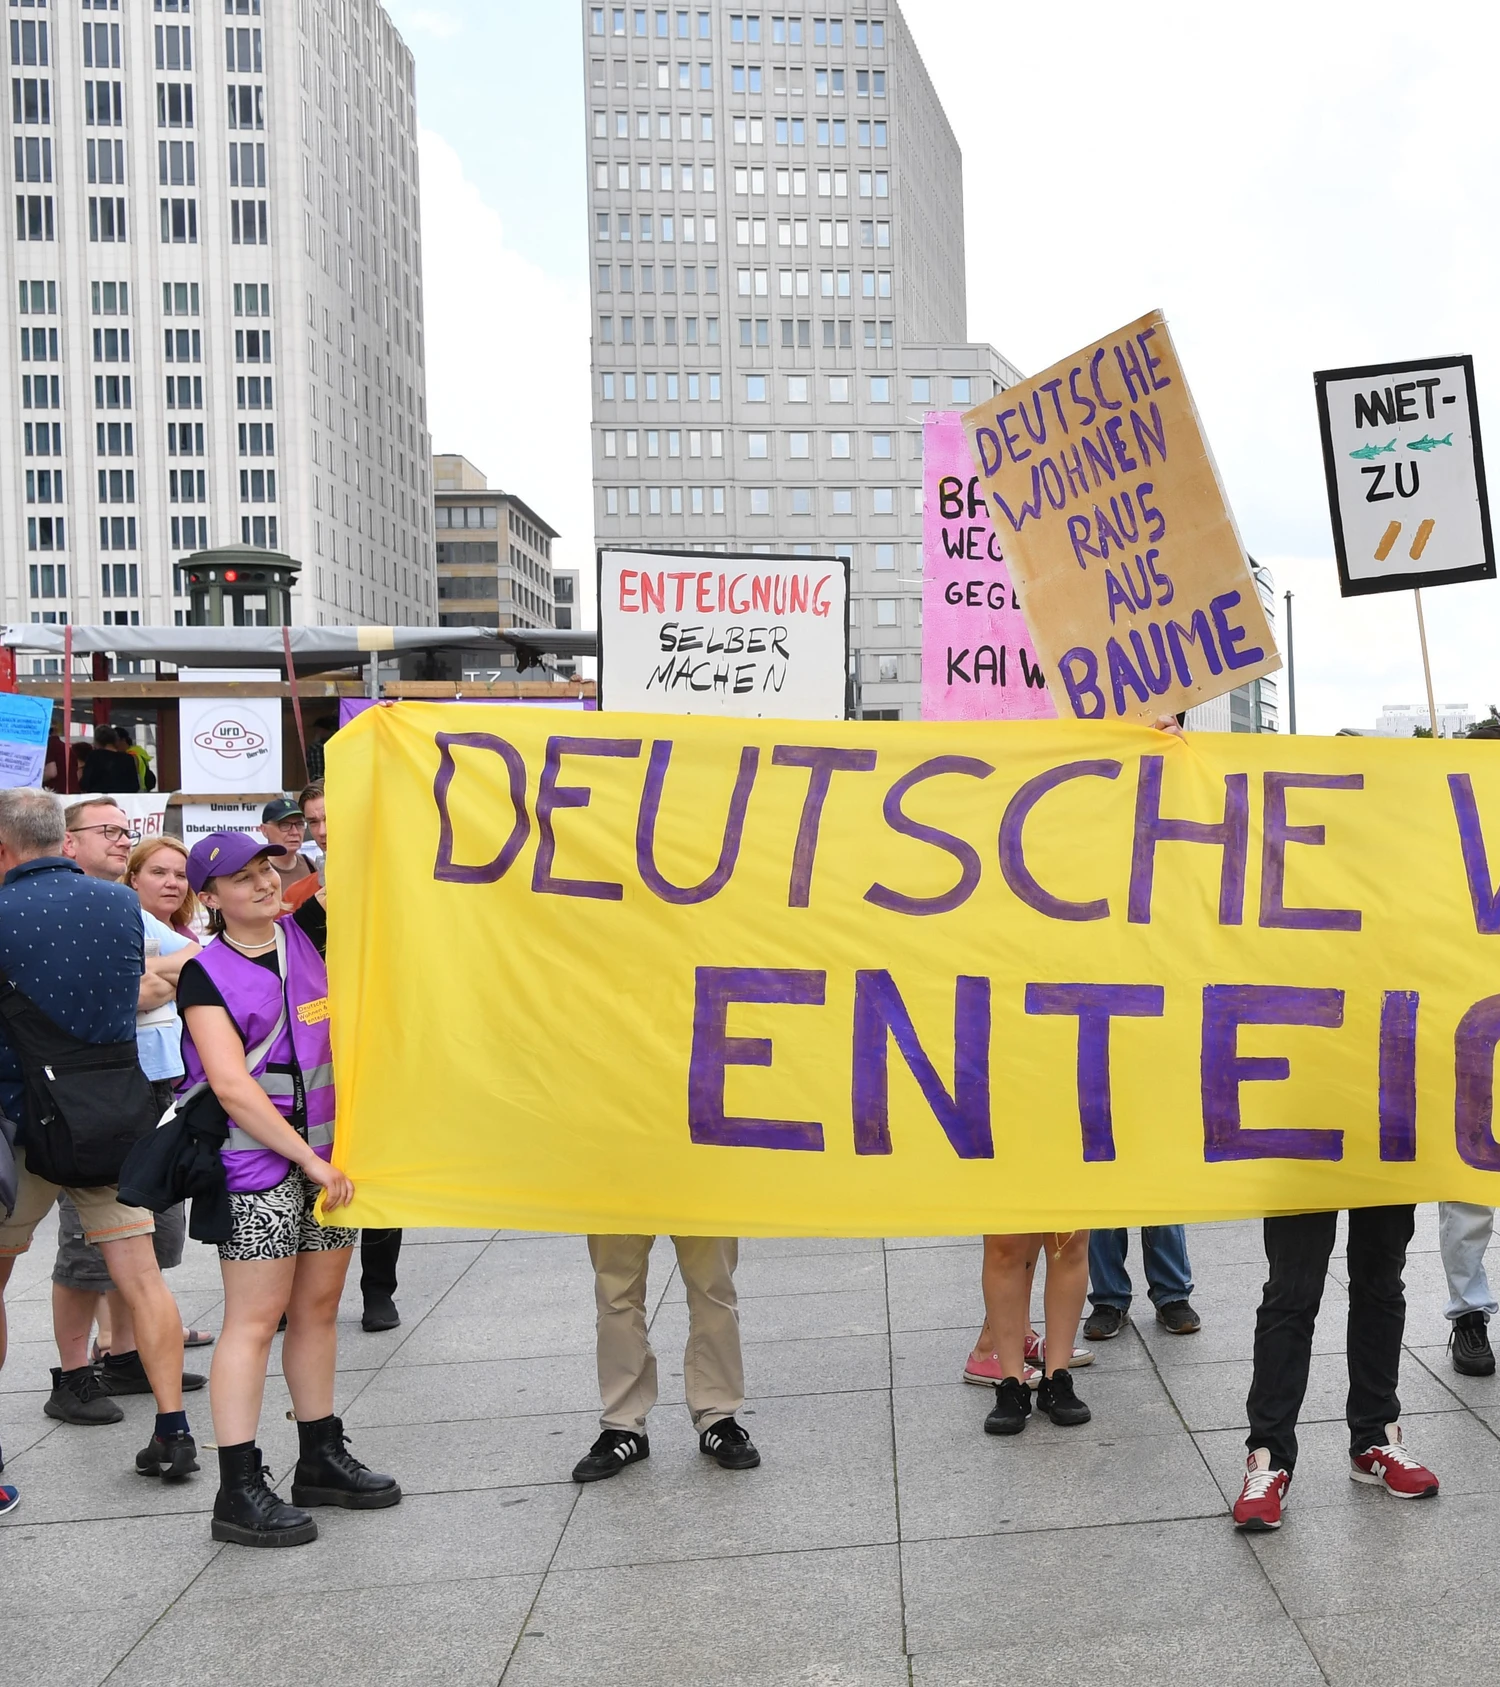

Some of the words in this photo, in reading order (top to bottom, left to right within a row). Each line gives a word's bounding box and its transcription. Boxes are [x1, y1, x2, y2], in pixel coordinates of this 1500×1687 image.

[976, 328, 1171, 478] DEUTSCHE
[993, 402, 1167, 532] WOHNEN
[1360, 461, 1420, 502] ZU
[1067, 483, 1166, 570] RAUS
[619, 569, 832, 617] ENTEIGNUNG
[1105, 549, 1174, 625] AUS
[660, 622, 790, 660] SELBER
[948, 645, 1007, 687] KAI
[1057, 590, 1264, 719] BAUME
[646, 655, 787, 693] MACHEN
[210, 802, 239, 811] Union
[434, 731, 1364, 931] DEUTSCHE
